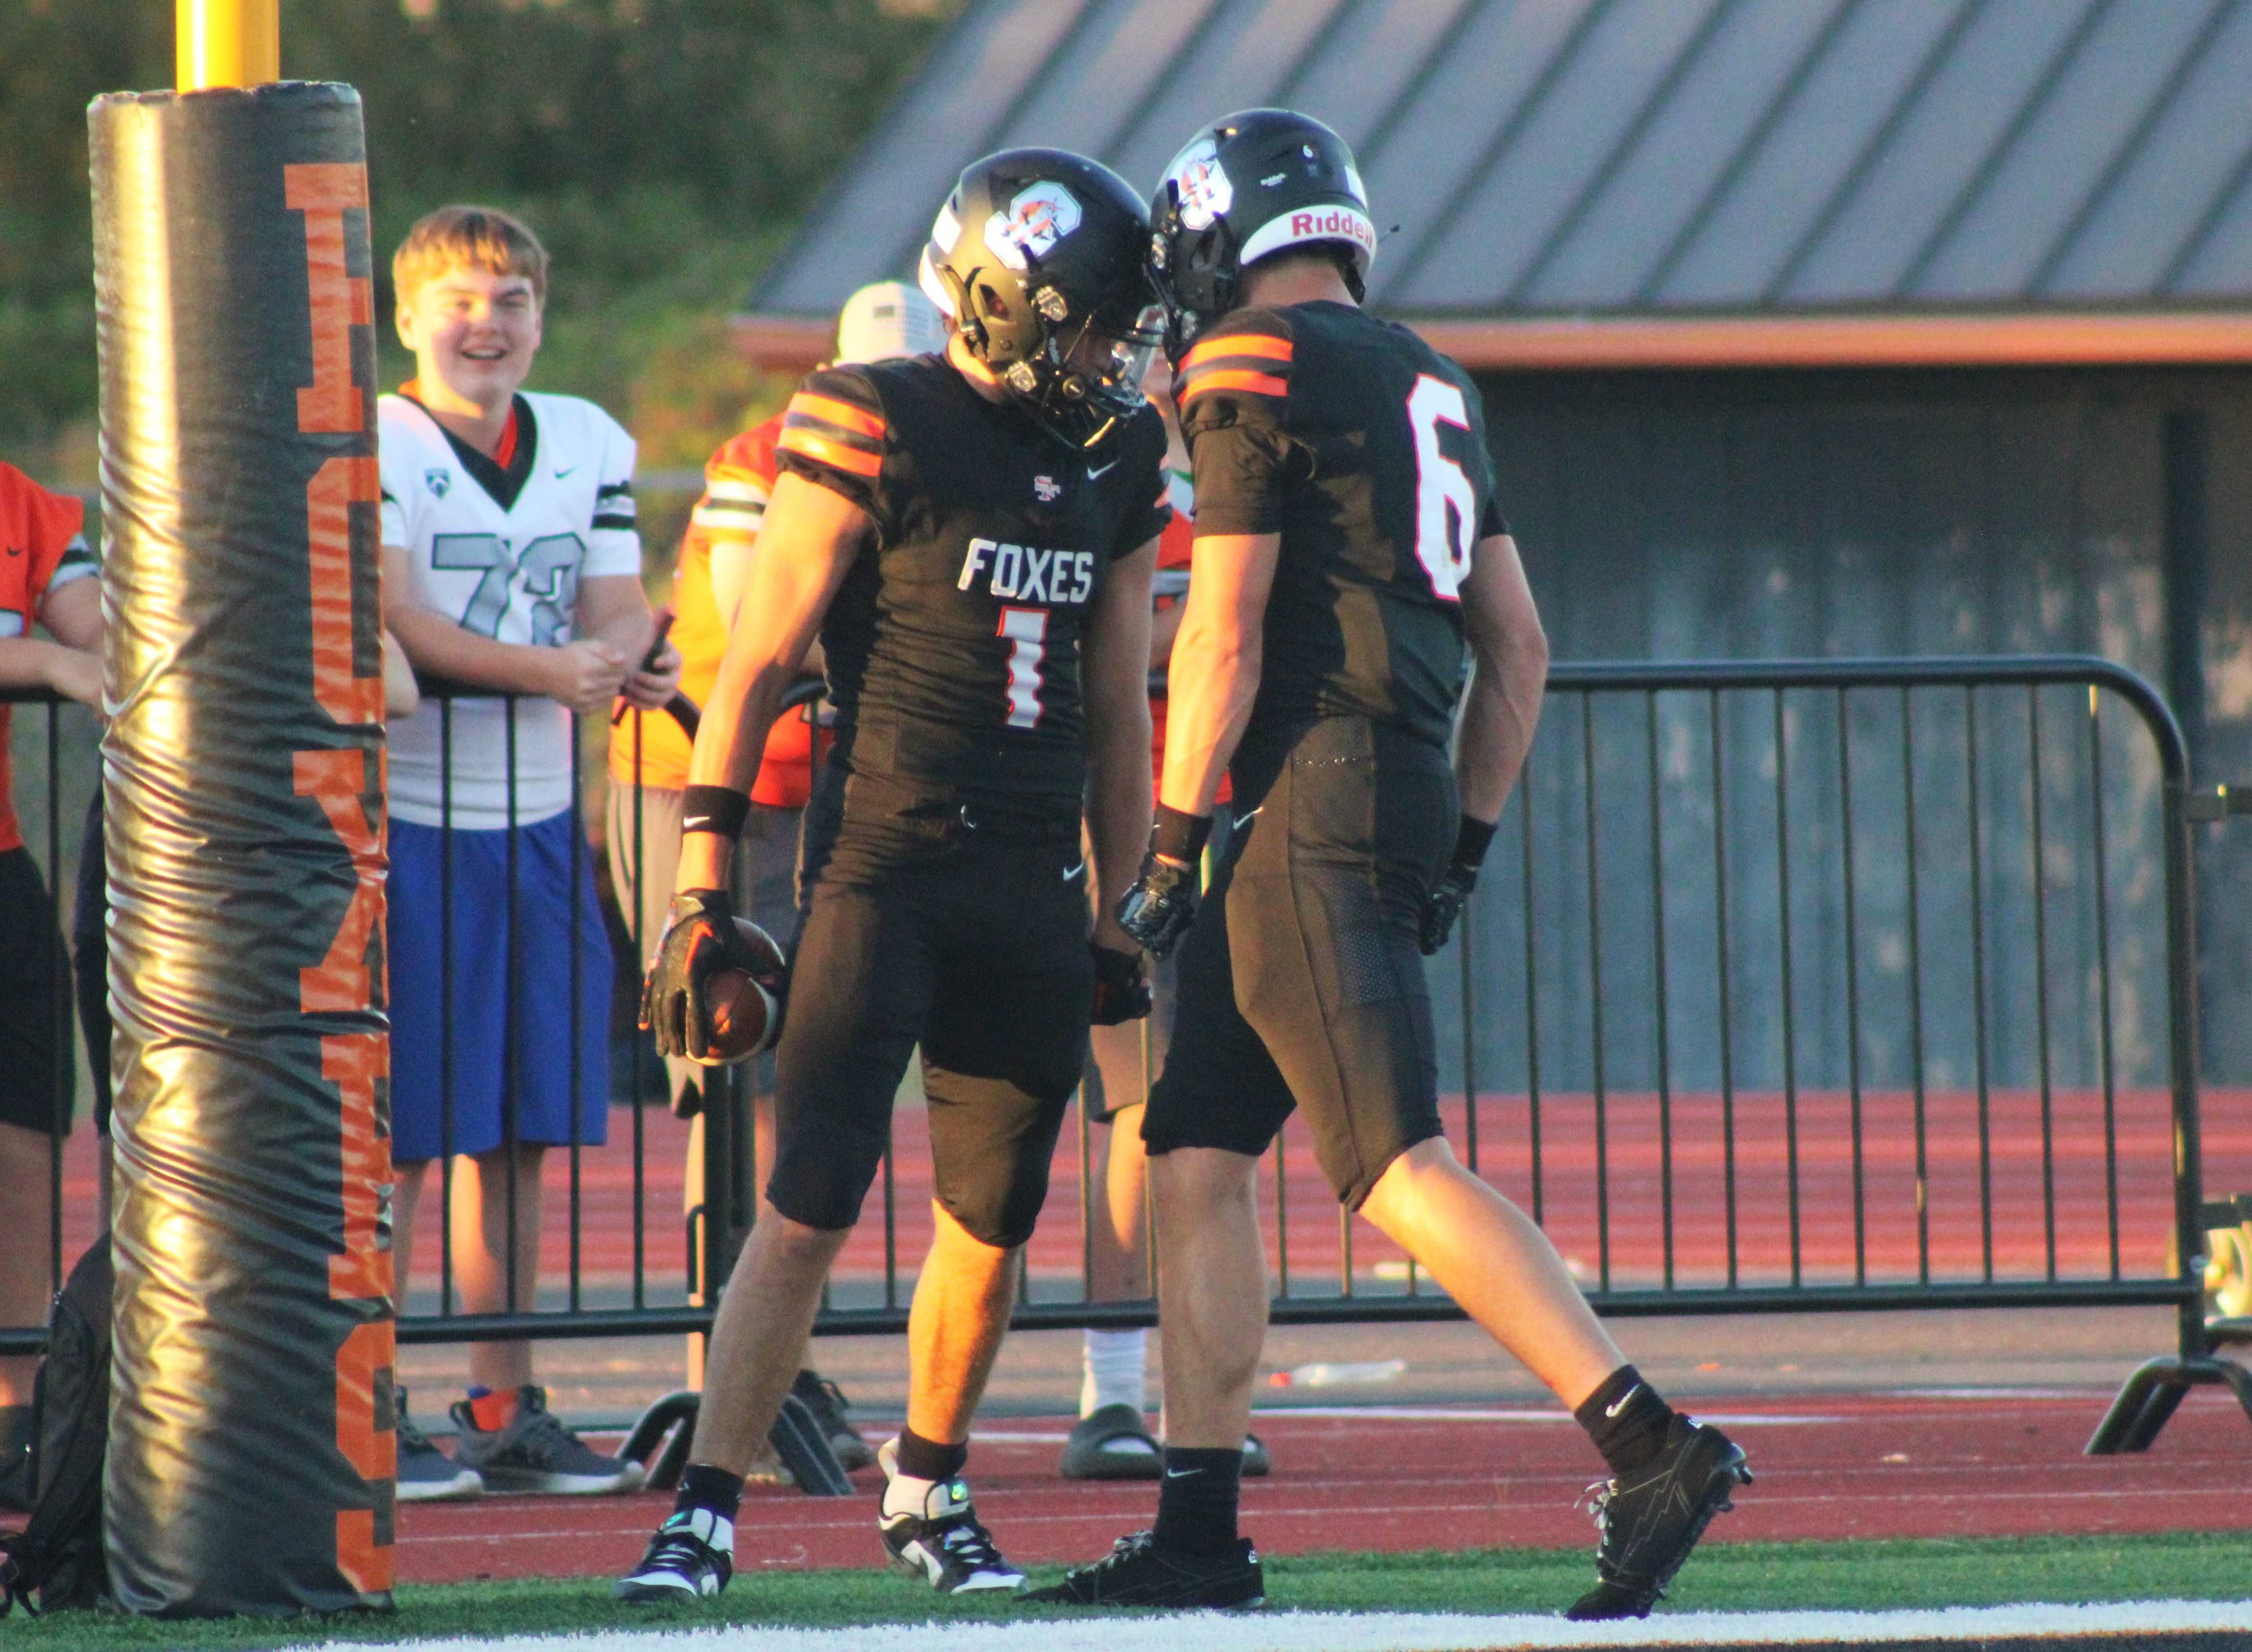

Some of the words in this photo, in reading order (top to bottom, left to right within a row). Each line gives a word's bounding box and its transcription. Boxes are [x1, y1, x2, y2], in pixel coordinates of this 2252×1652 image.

[1291, 211, 1373, 249] Riddell
[1406, 372, 1476, 603] 6
[957, 537, 1094, 604] FOXES
[996, 605, 1051, 729] 1
